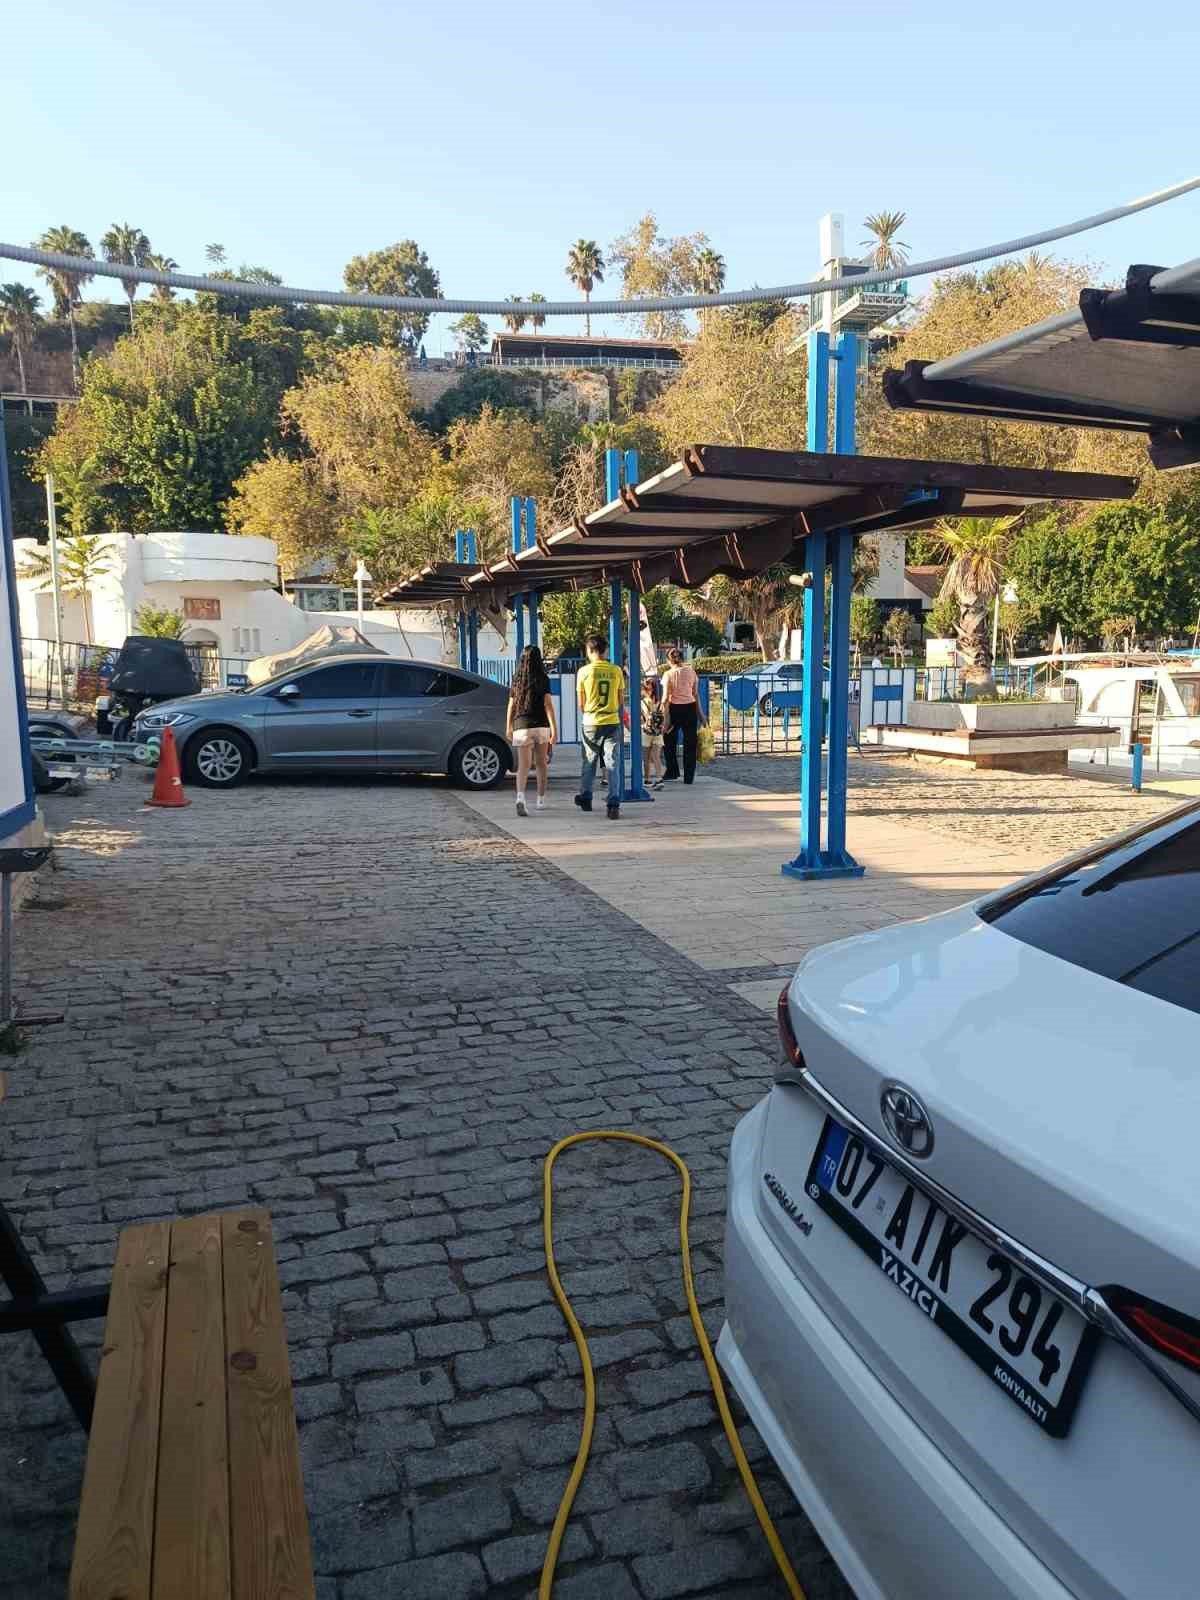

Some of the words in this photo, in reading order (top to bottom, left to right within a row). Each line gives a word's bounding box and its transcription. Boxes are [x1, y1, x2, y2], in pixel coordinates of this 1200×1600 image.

[598, 680, 610, 708] 9
[823, 1155, 837, 1177] TR
[836, 1137, 886, 1209] 07
[969, 1253, 1064, 1387] 294
[880, 1249, 938, 1318] YAZICI
[993, 1364, 1047, 1422] KONYAALTI
